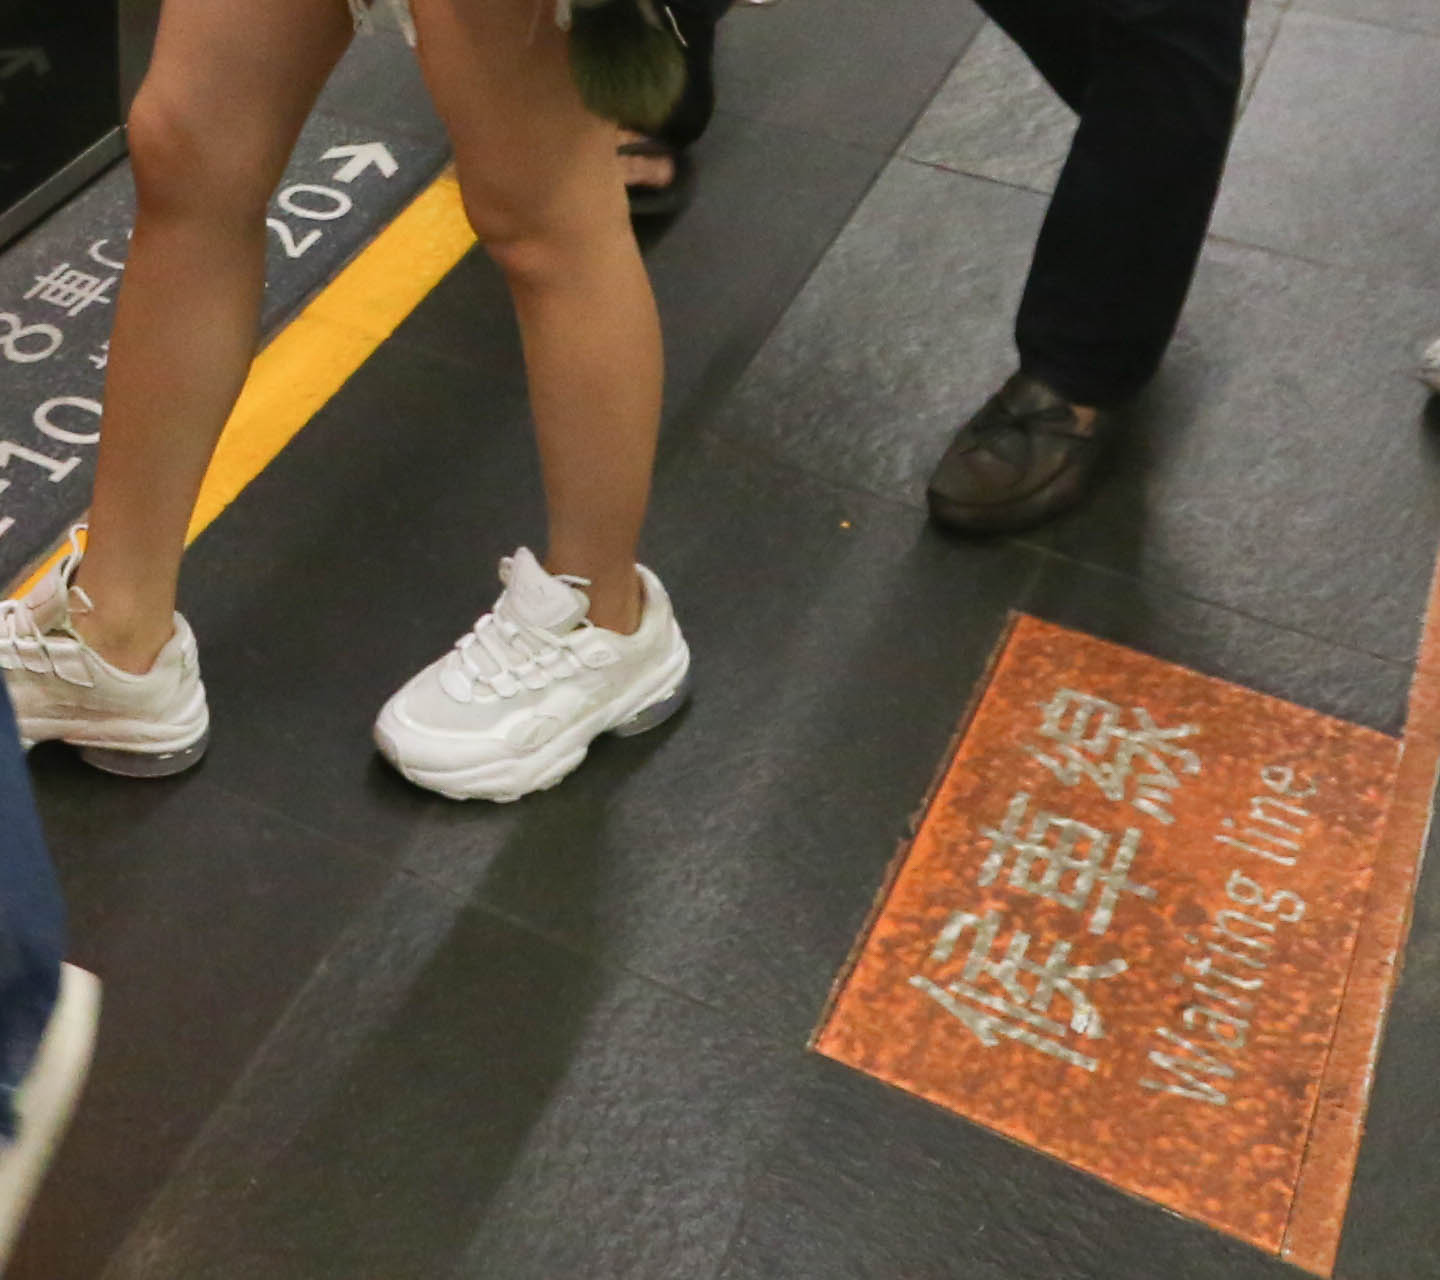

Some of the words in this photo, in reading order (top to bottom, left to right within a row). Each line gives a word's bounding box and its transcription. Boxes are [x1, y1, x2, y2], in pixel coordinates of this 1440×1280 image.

[908, 687, 1202, 1073] 候車線
[1212, 761, 1318, 868] line
[1138, 867, 1308, 1107] Waiting
